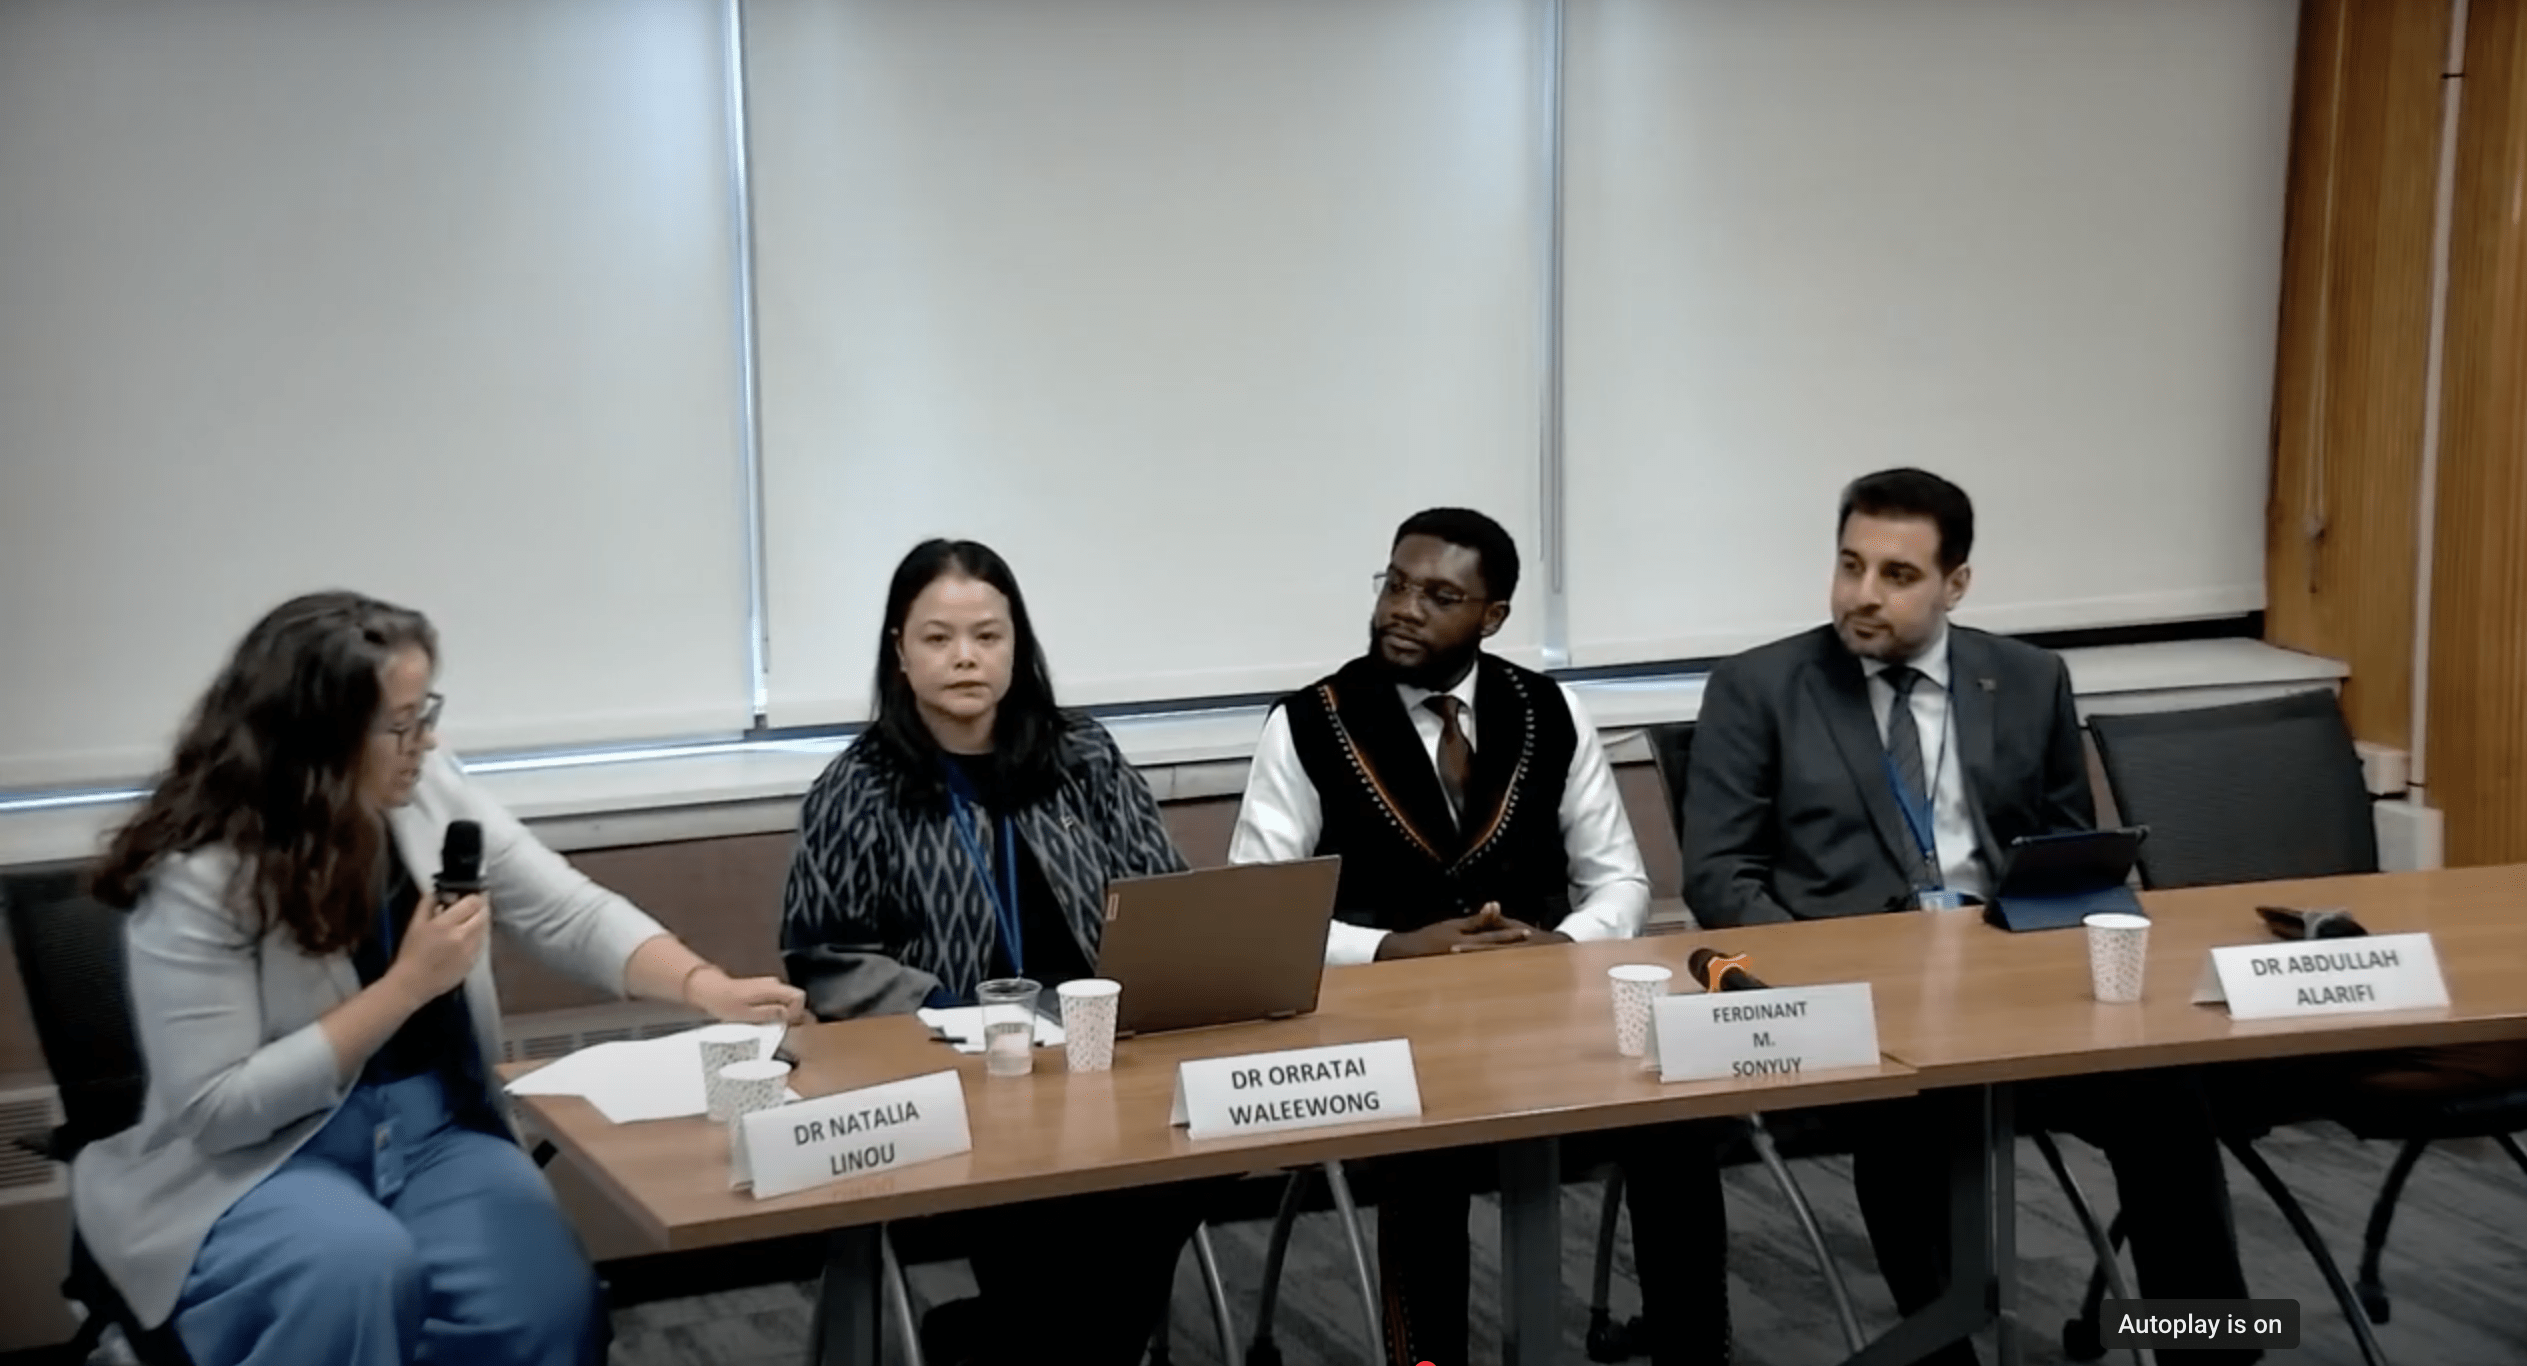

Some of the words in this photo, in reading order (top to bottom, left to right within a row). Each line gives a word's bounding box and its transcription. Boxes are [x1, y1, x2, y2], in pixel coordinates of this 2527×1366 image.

[2251, 958, 2283, 977] DR
[2287, 949, 2399, 974] ABDULLAH
[2297, 984, 2375, 1006] ALARIFI
[1713, 1001, 1807, 1023] FERDINANT
[1753, 1032, 1776, 1048] M.
[1231, 1068, 1263, 1090] DR
[1268, 1057, 1366, 1086] ORRATAI
[1732, 1057, 1802, 1077] SONYUY
[1228, 1091, 1380, 1125] WALEEWONG
[794, 1121, 825, 1146] DR
[829, 1101, 920, 1138] NATALIA
[830, 1142, 895, 1176] LINOU
